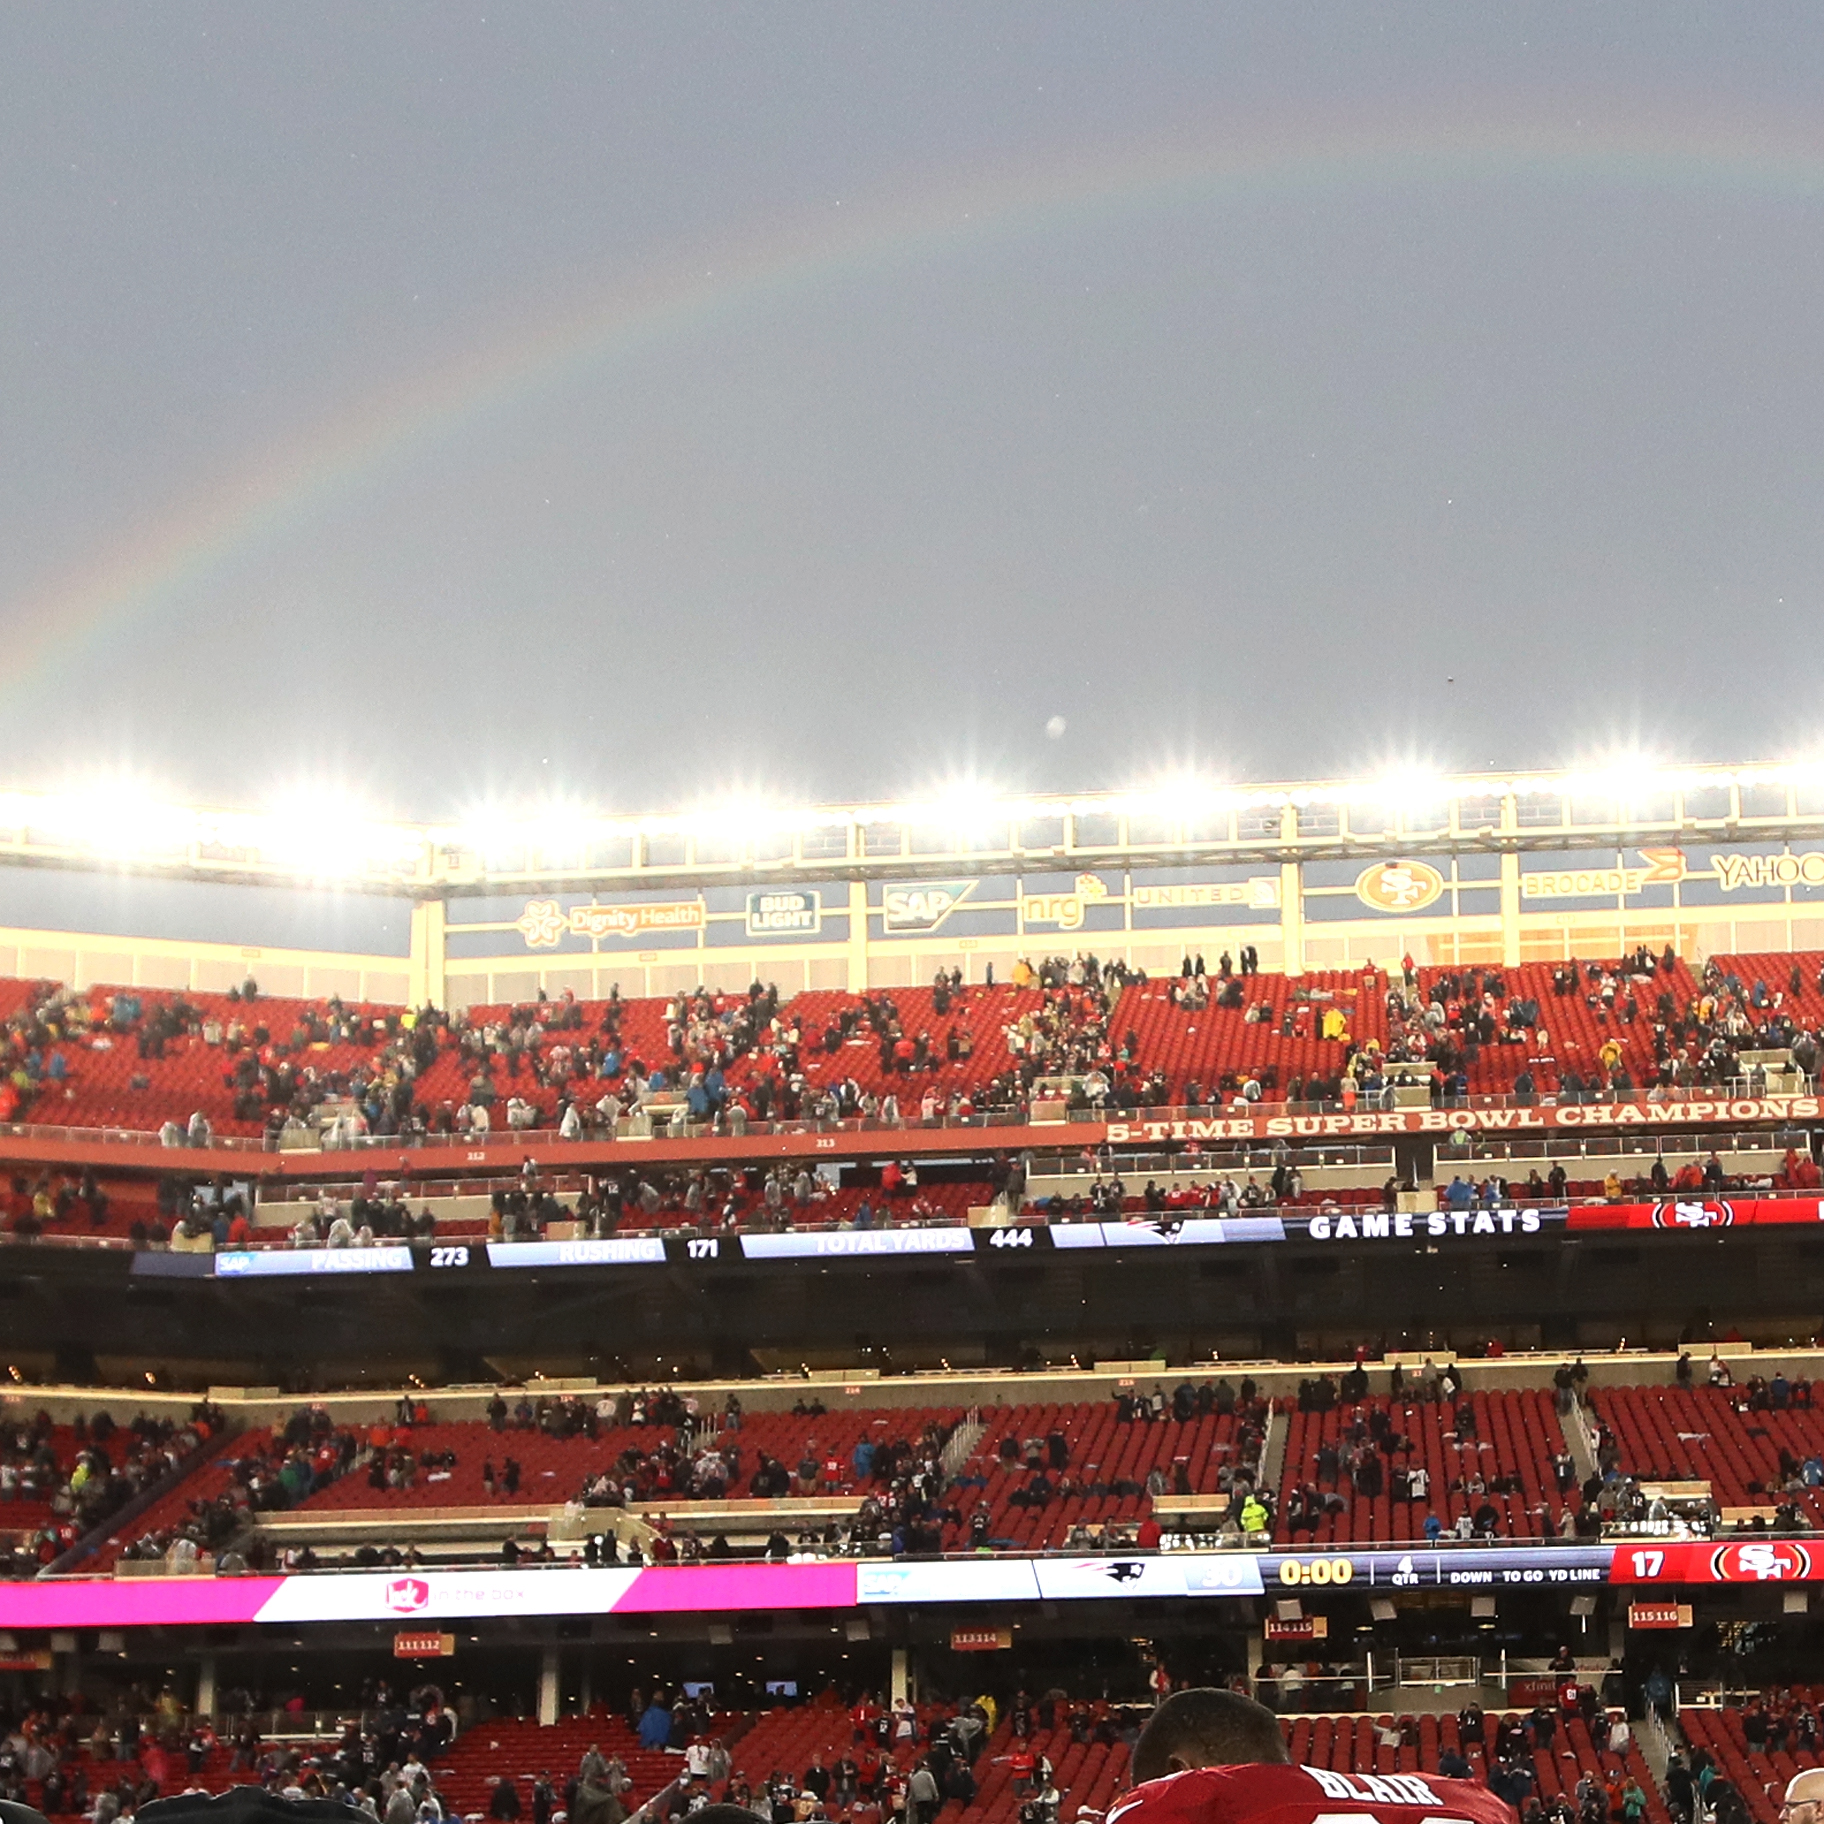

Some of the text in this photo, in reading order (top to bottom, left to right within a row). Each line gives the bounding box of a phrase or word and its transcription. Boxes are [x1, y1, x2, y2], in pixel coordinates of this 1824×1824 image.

[1526, 872, 1638, 895] BROCADE
[760, 893, 806, 911] BUD
[887, 891, 952, 922] SAP
[1137, 886, 1244, 905] UNITED
[575, 905, 700, 934] Dignity Health
[752, 910, 813, 928] LIGHT
[1027, 894, 1080, 925] nrg
[1107, 1098, 1819, 1142] 5-TIME SUPER BOWL CHAMPIONS
[1308, 1208, 1541, 1240] GAME STATS
[559, 1238, 719, 1262] RUSHING 171
[817, 1228, 1034, 1252] TOTAL YARDS 444
[219, 1255, 250, 1272] SAP
[311, 1246, 470, 1271] PASSING 273
[1280, 1559, 1353, 1585] 0:00
[1397, 1555, 1413, 1573] 4
[1549, 1568, 1601, 1582] YD LINE
[1631, 1550, 1665, 1579] 17
[1392, 1573, 1419, 1586] QTR
[1450, 1571, 1493, 1584] DOWN
[1503, 1570, 1544, 1583] TO GO
[1632, 1611, 1678, 1624] 115 116
[1524, 1680, 1558, 1692] xfinit
[1300, 1764, 1444, 1805] BLAIR
